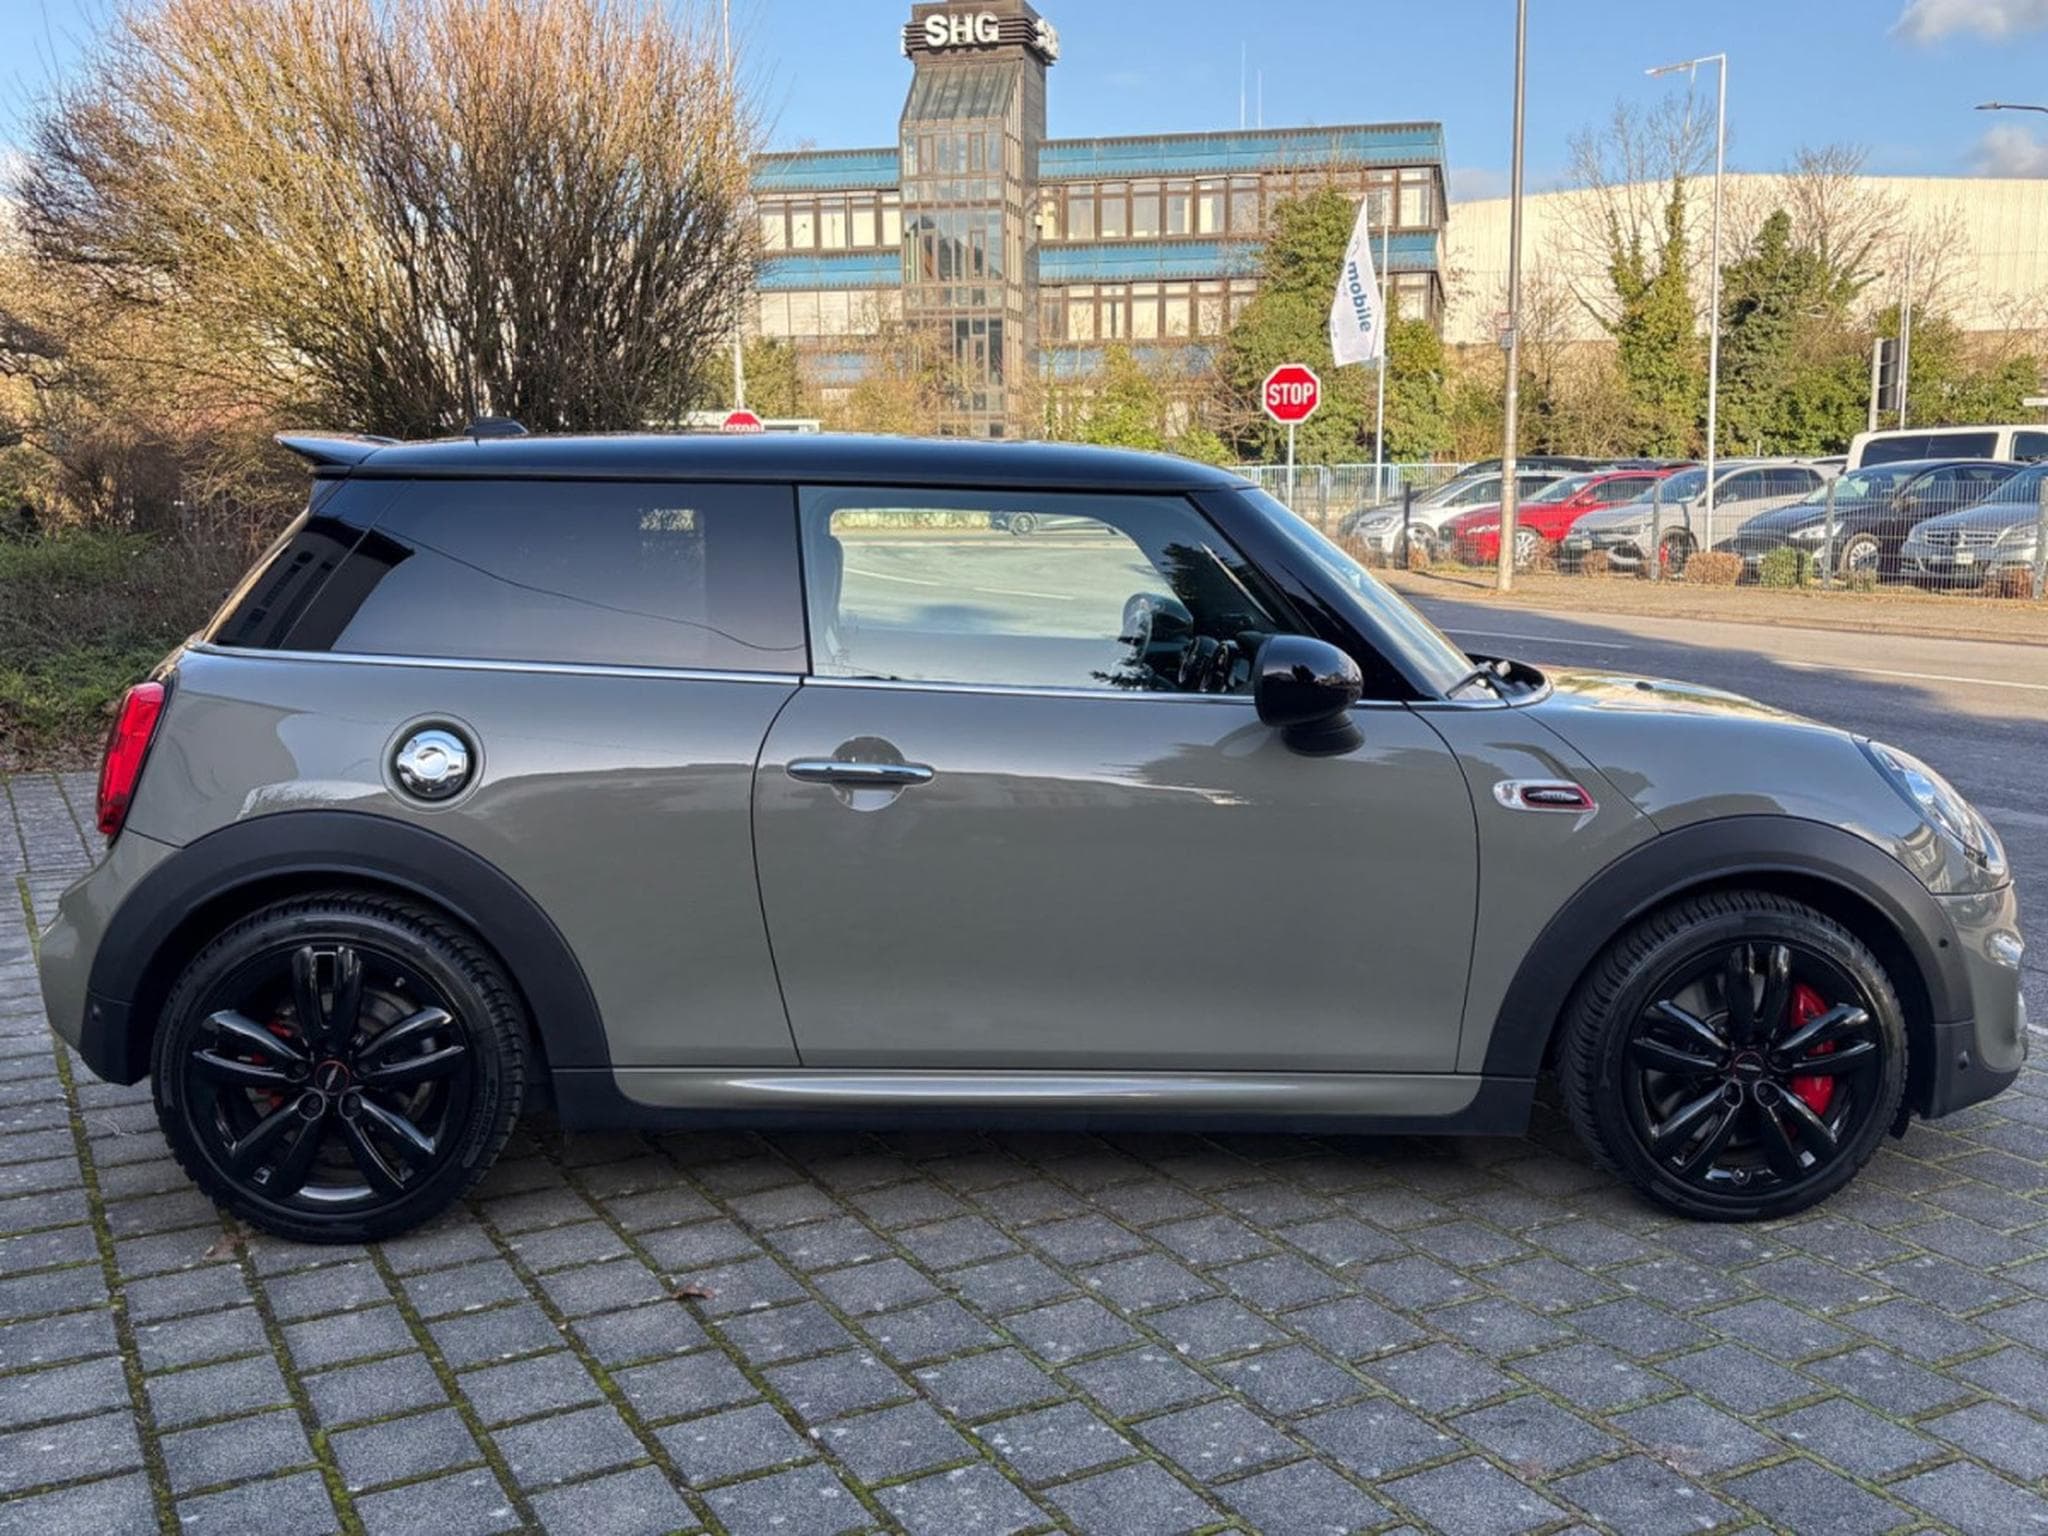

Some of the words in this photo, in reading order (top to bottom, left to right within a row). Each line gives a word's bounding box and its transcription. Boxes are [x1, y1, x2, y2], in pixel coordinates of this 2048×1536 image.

[925, 12, 999, 47] SHG
[1347, 260, 1372, 332] mobile
[1268, 382, 1314, 405] STOP
